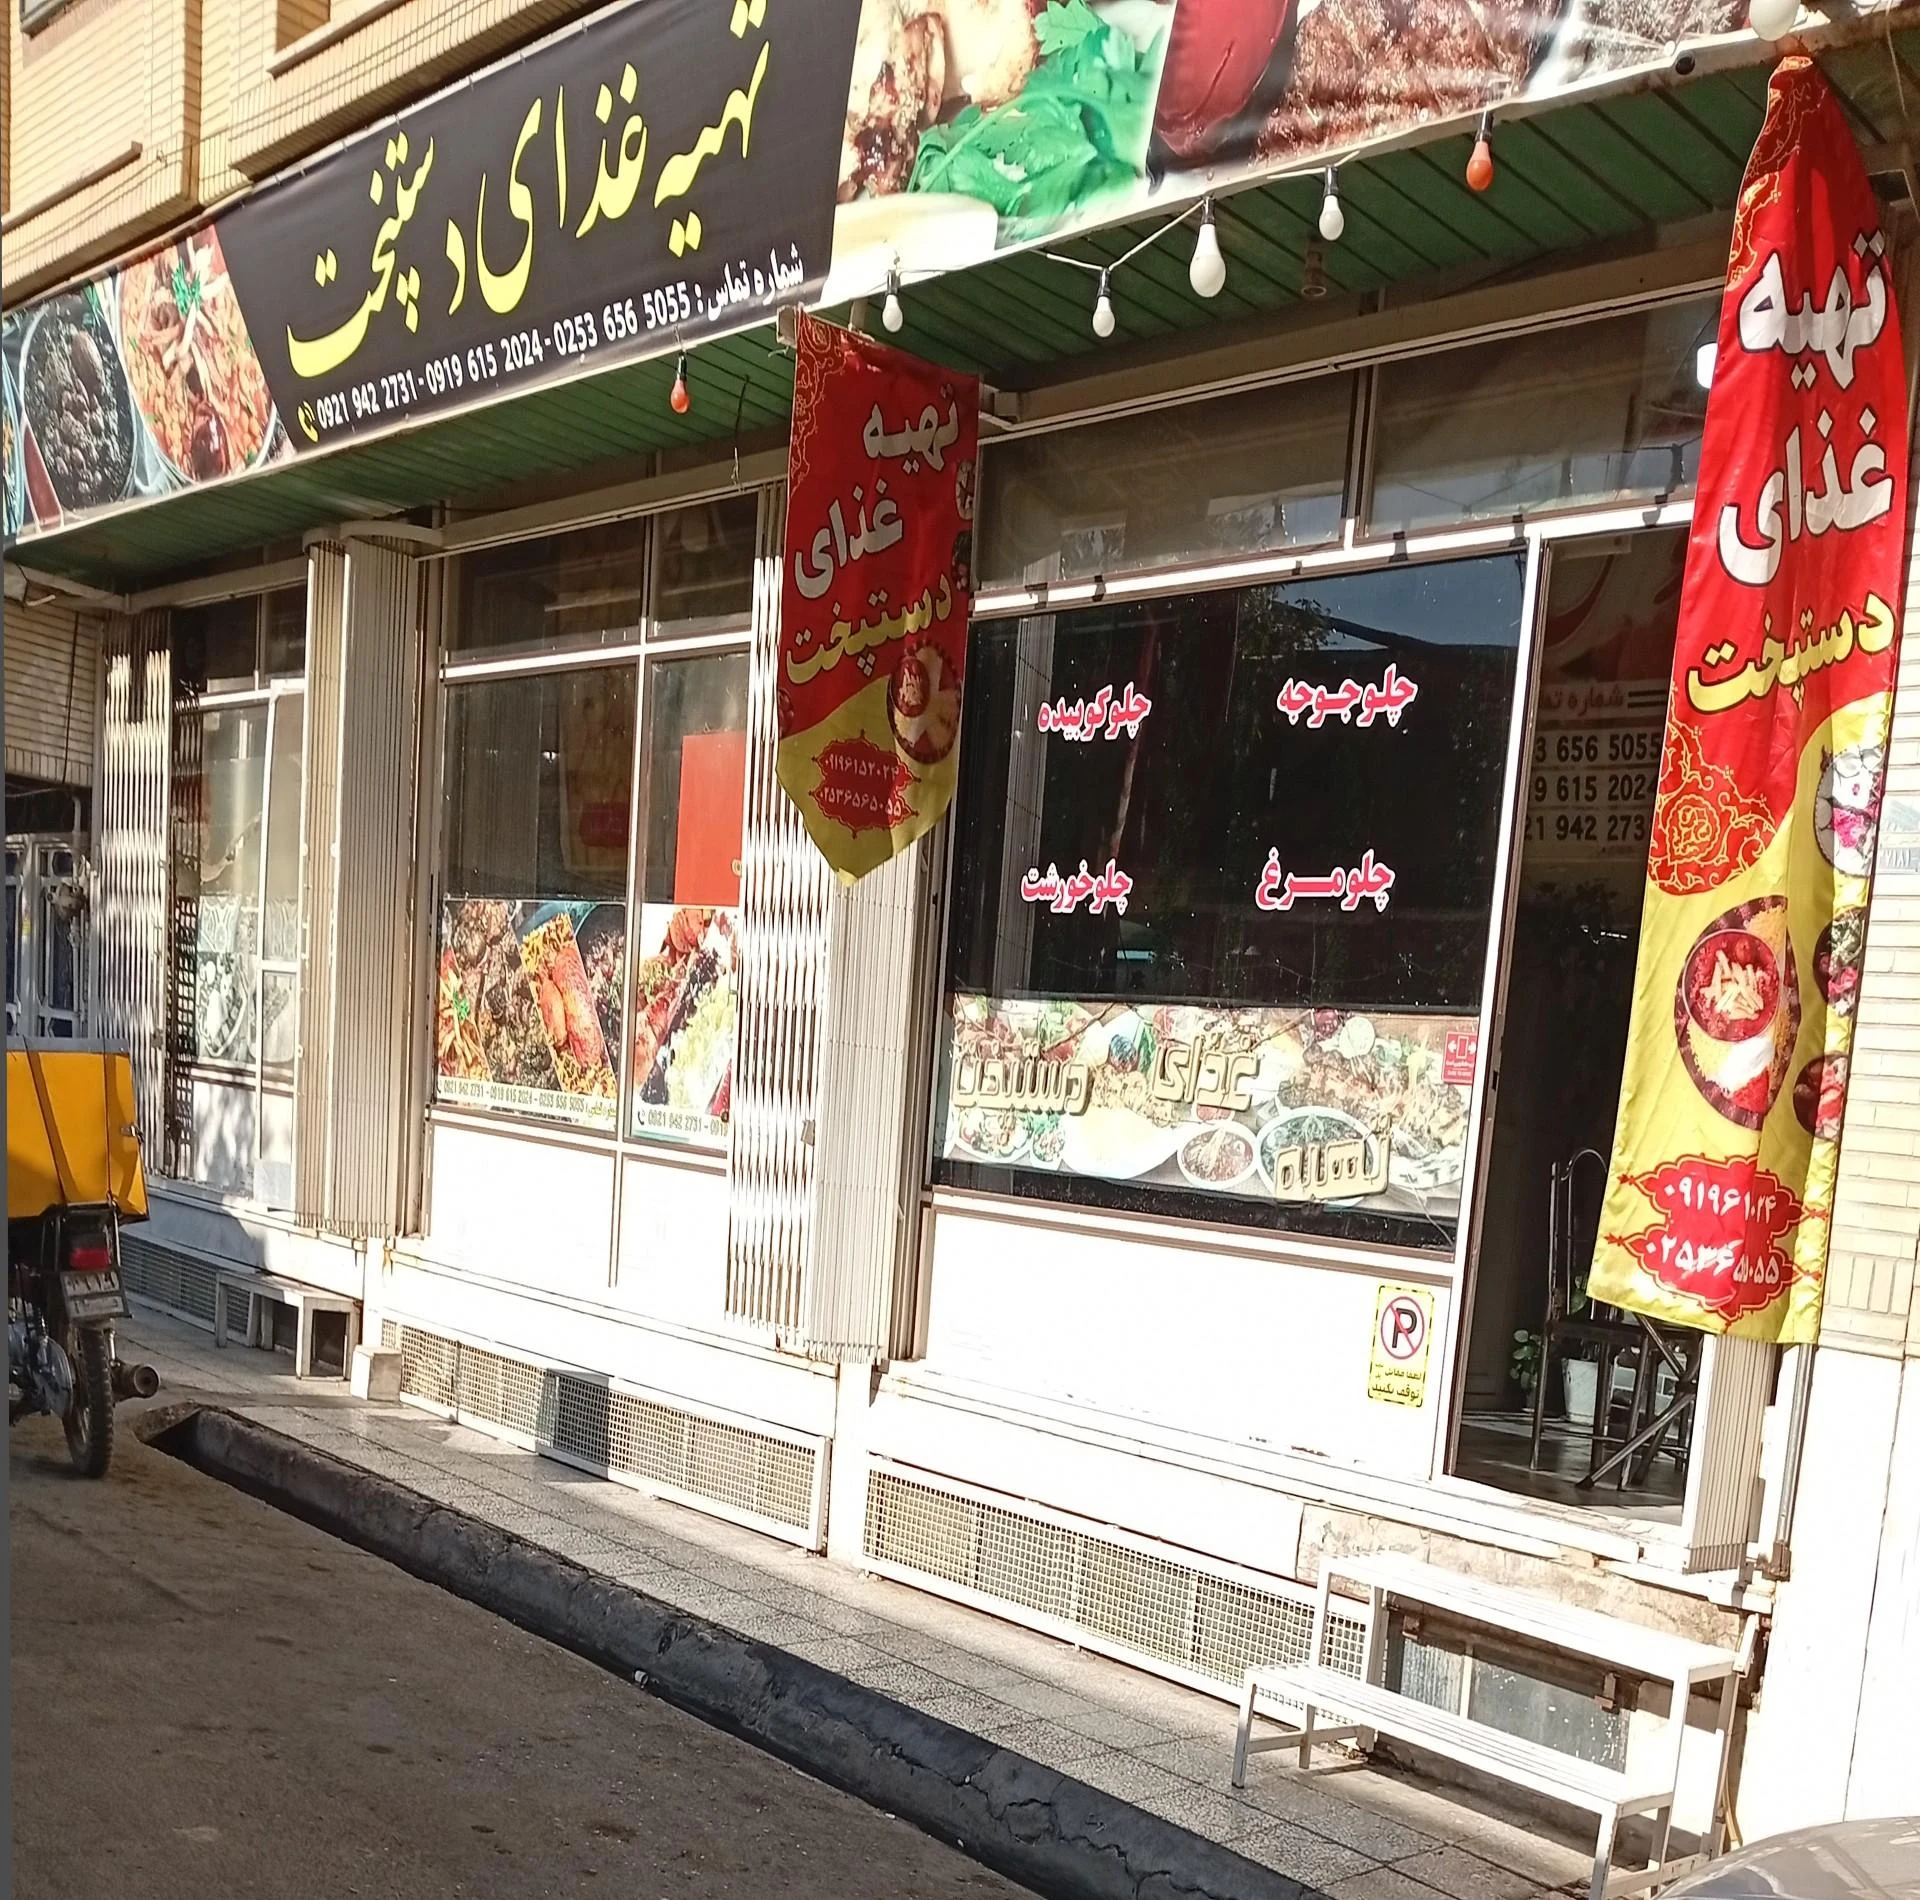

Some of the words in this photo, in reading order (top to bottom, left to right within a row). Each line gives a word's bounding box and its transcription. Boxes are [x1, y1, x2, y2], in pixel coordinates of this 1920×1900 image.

[475, 62, 648, 314] غذای
[654, 0, 770, 257] تهیه
[753, 241, 804, 306] شماره
[1737, 227, 1888, 391] تهیه
[316, 391, 350, 430] 0921
[351, 382, 381, 419] 942
[466, 342, 498, 383] 615
[602, 298, 639, 341] 656
[642, 281, 692, 330] 5055
[863, 383, 959, 474] تهیه
[793, 479, 904, 599] غذای
[1715, 405, 1895, 587] غذای
[785, 571, 954, 685] دستپخت
[1684, 586, 1896, 714] دستپخت
[1556, 735, 1598, 762] 656
[1609, 733, 1662, 761] 5055
[1556, 775, 1598, 802] 615
[1556, 814, 1598, 841] 942
